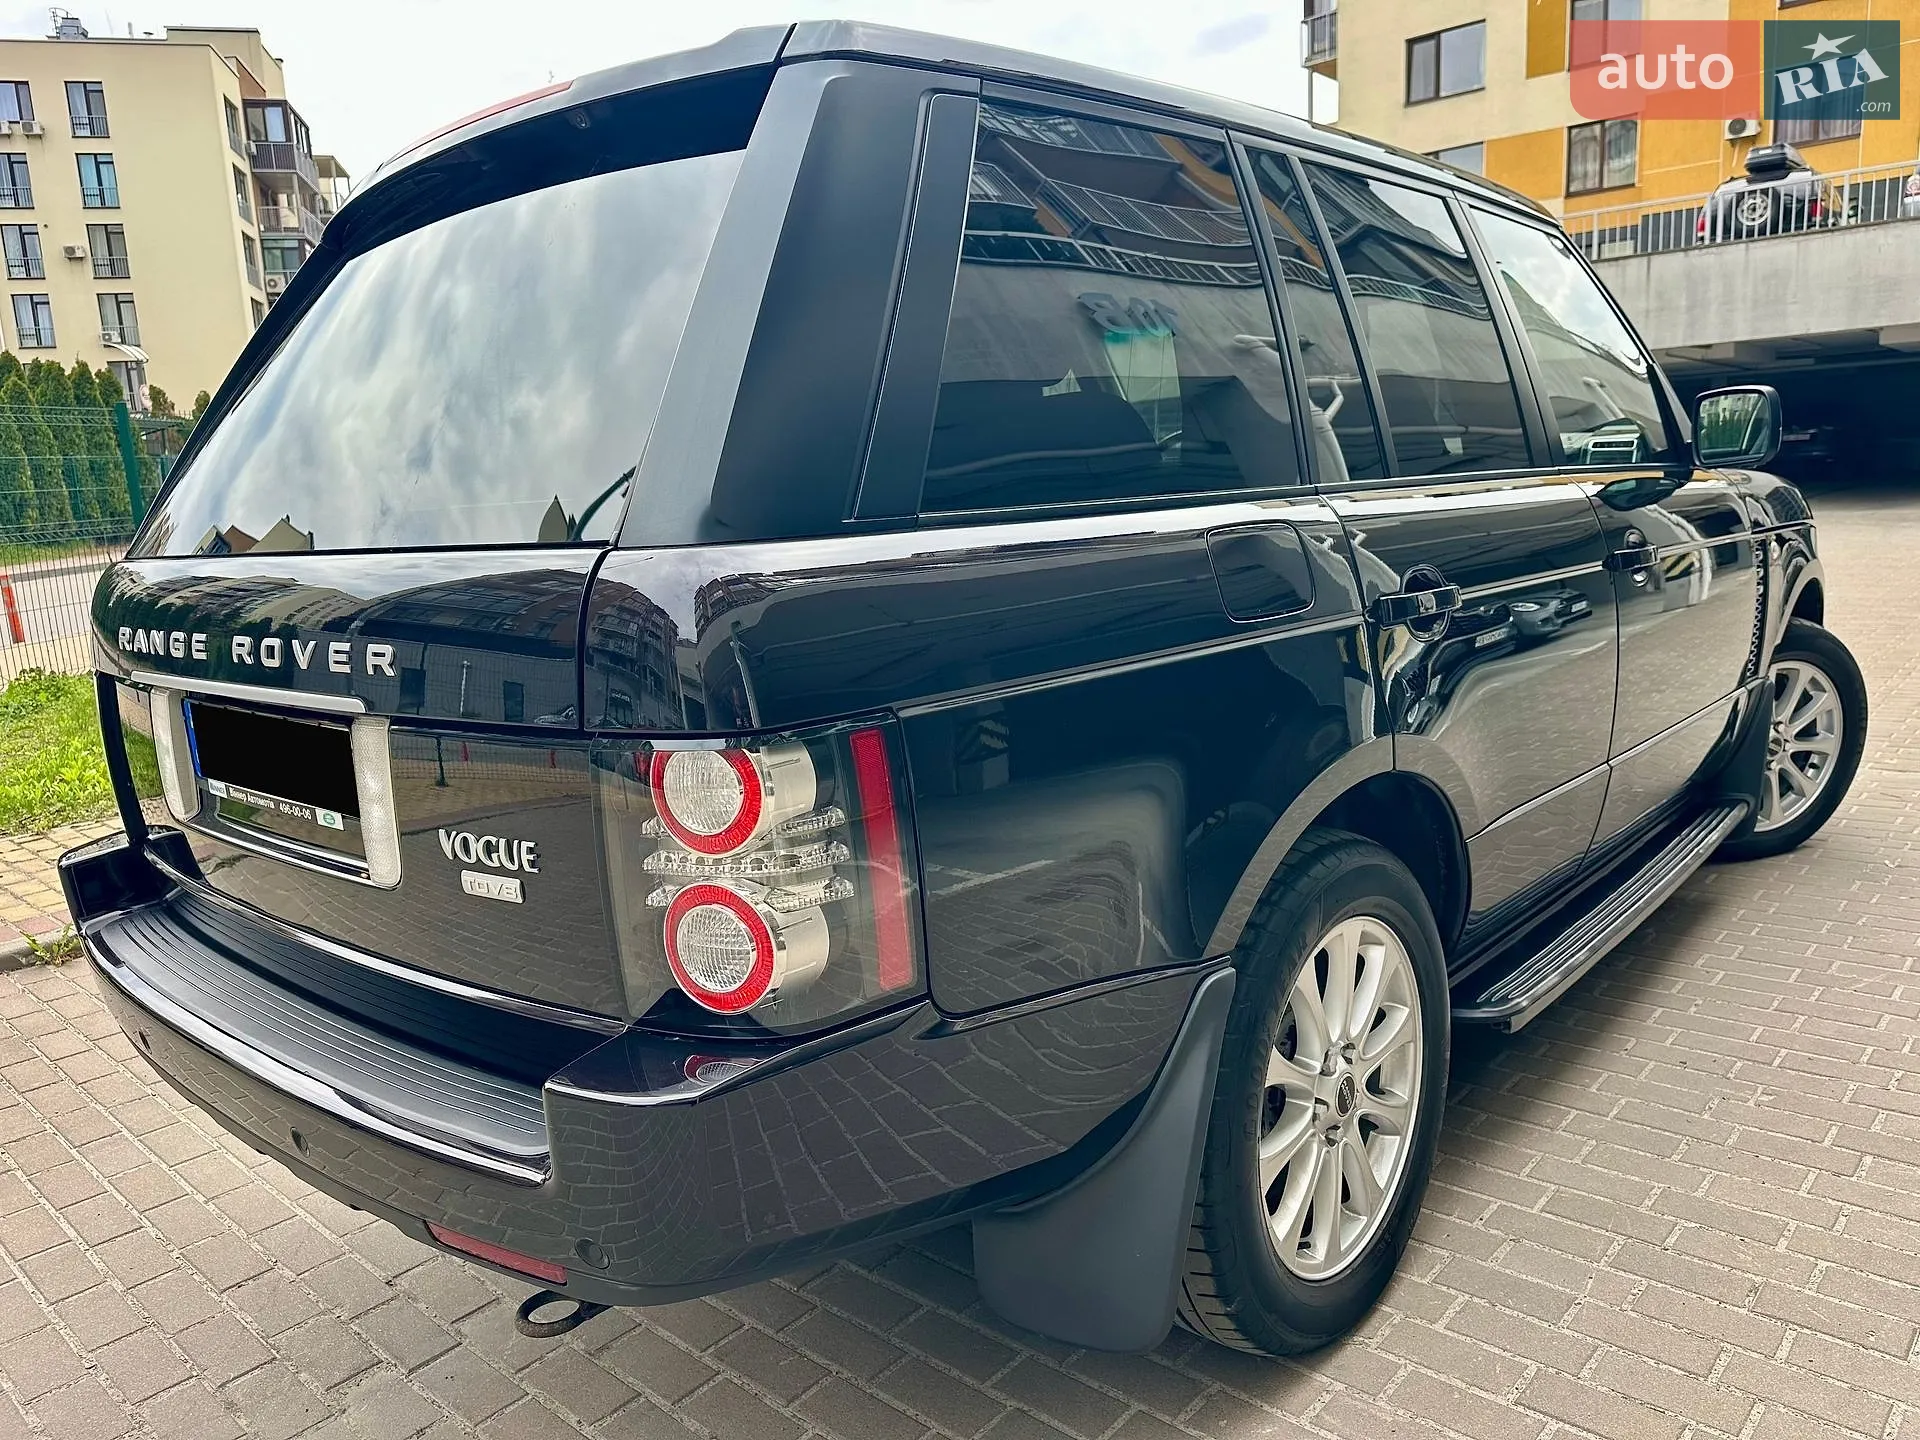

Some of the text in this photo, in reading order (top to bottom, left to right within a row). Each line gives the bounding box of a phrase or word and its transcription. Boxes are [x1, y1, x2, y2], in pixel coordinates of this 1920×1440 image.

[119, 626, 397, 677] RANGE ROVER
[438, 828, 540, 874] VOGUE
[463, 875, 519, 899] TDV8
